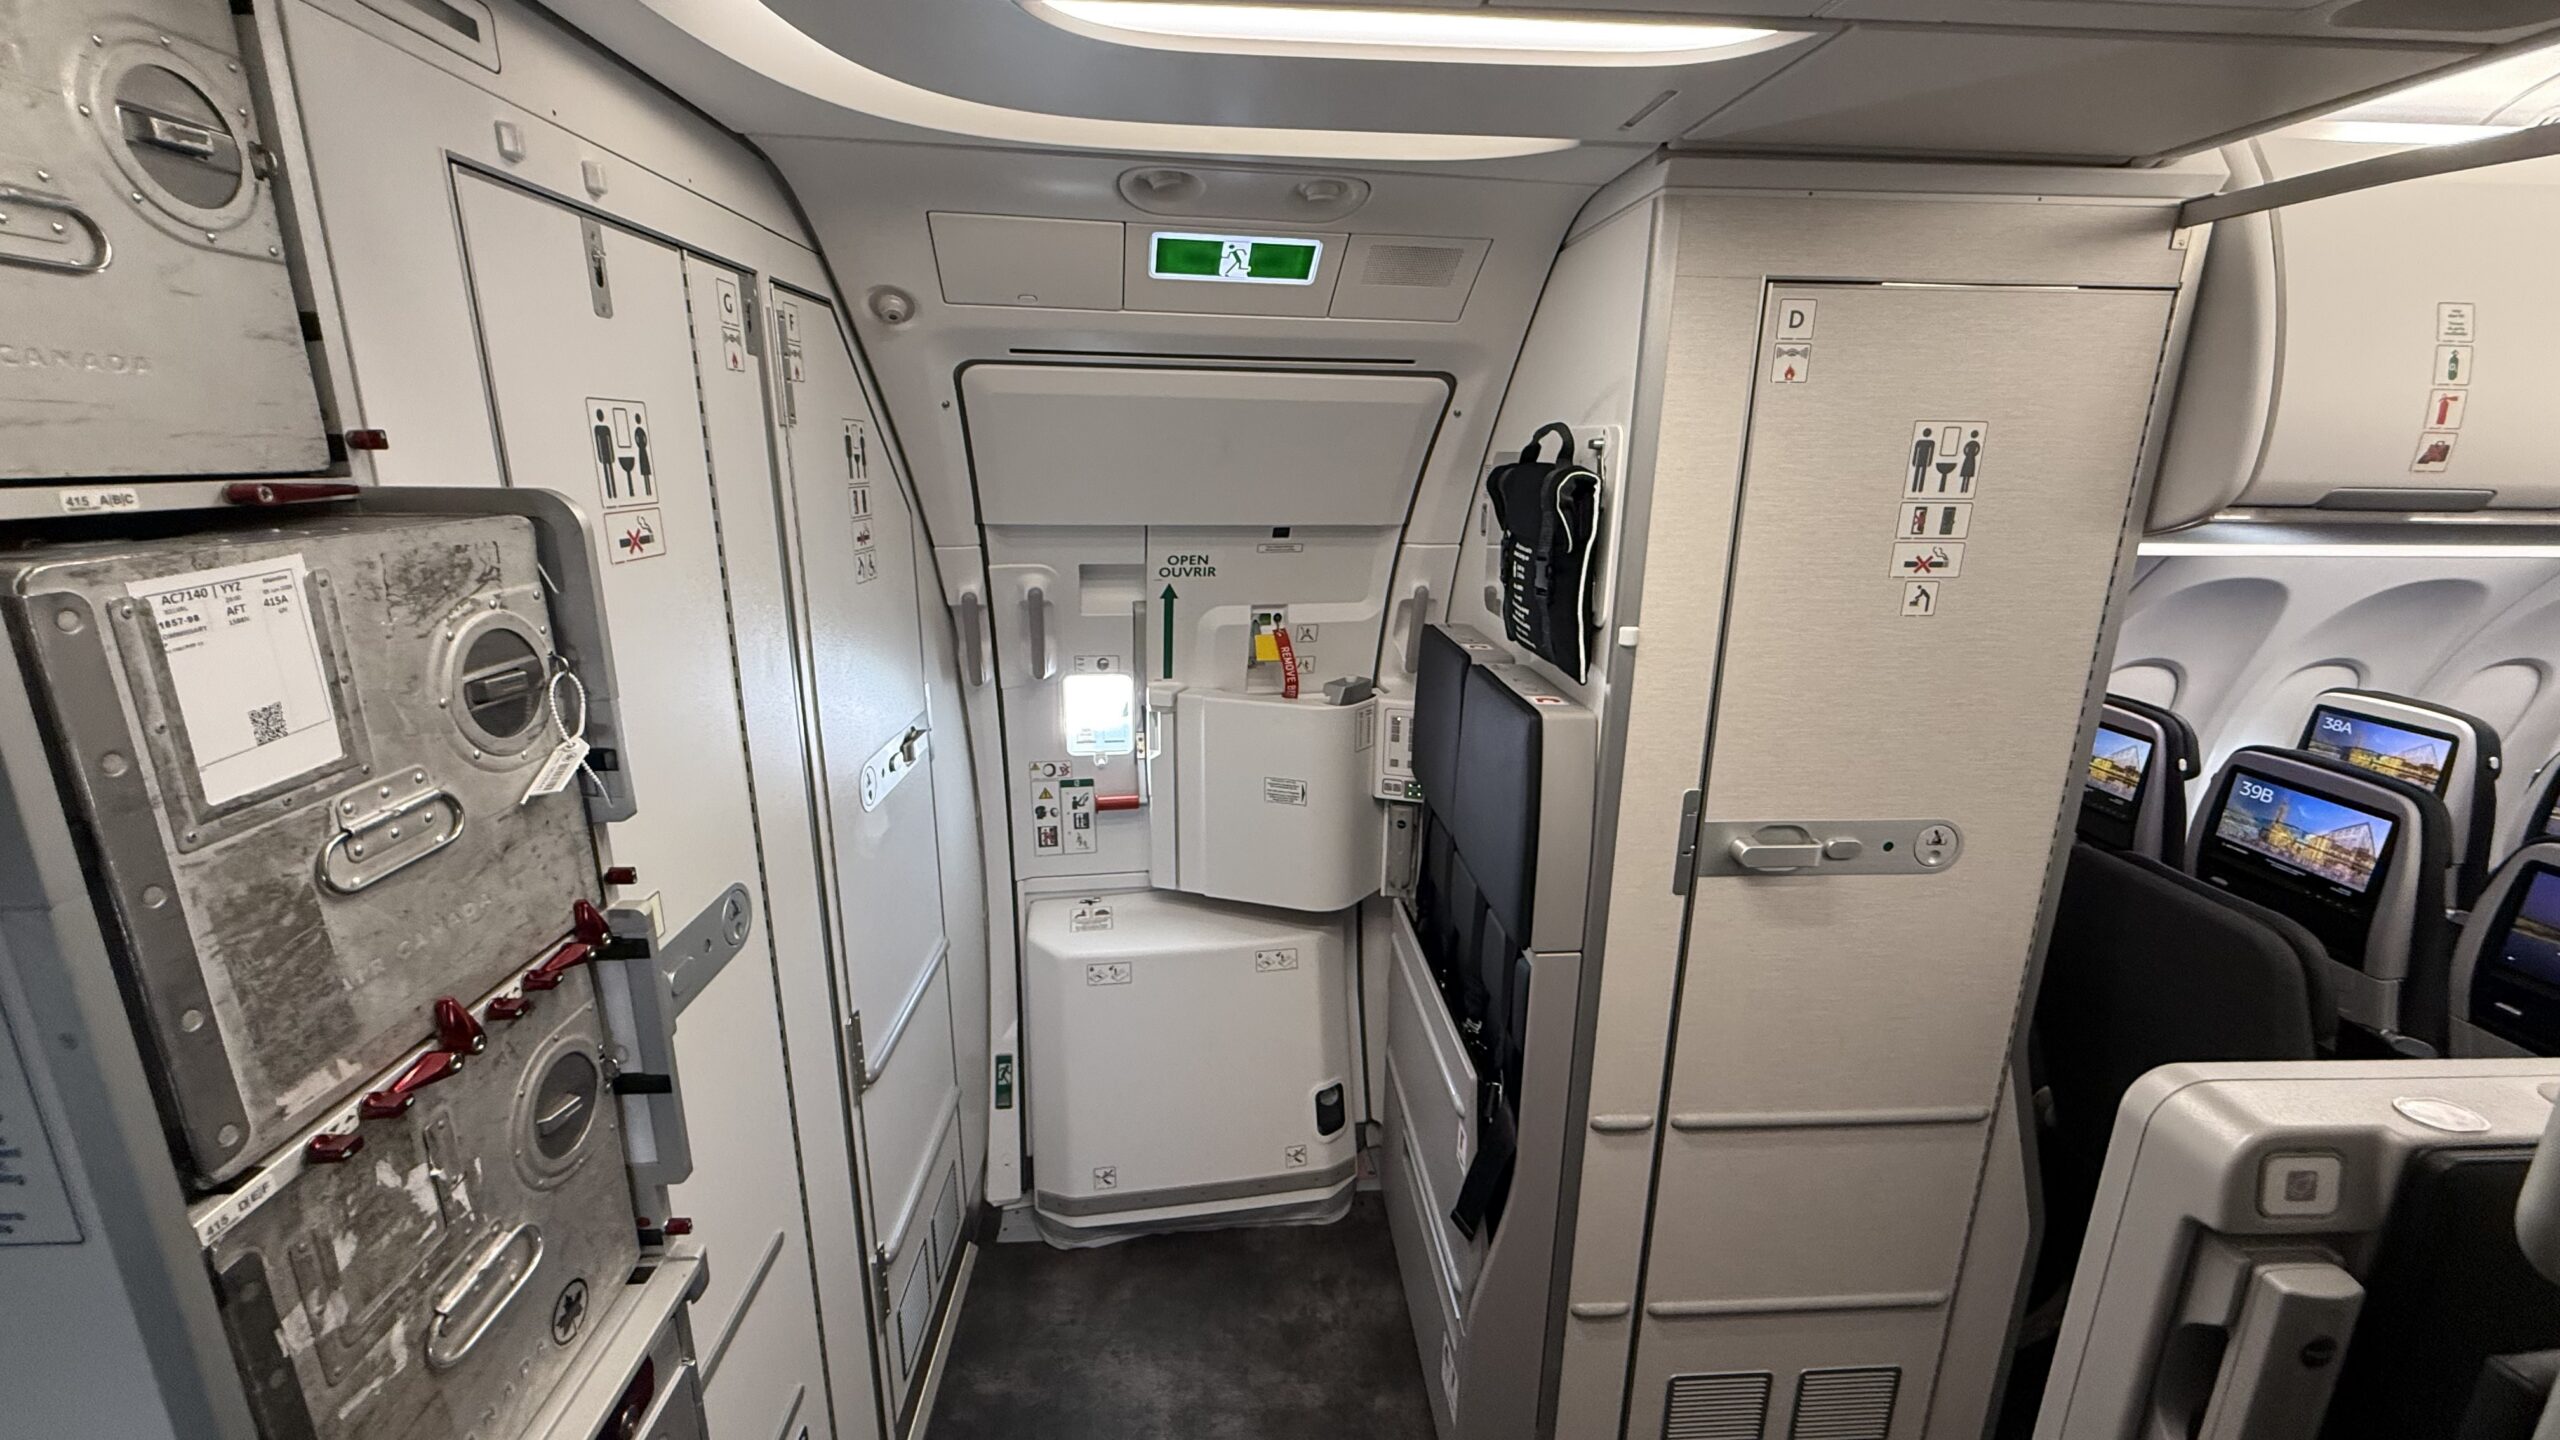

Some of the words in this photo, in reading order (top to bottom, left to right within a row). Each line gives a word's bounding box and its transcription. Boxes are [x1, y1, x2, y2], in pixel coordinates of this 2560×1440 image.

[723, 293, 733, 314] G
[1788, 309, 1805, 329] D
[65, 495, 90, 507] 415
[1167, 554, 1209, 566] OPEN
[1158, 566, 1217, 578] OUVRIR
[161, 587, 208, 605] AC7140
[220, 581, 243, 594] YYZ
[263, 594, 289, 608] 415A
[226, 603, 246, 616] AFT
[1280, 645, 1298, 683] REMOVE
[2322, 716, 2352, 735] 38A
[2239, 780, 2275, 804] 39B
